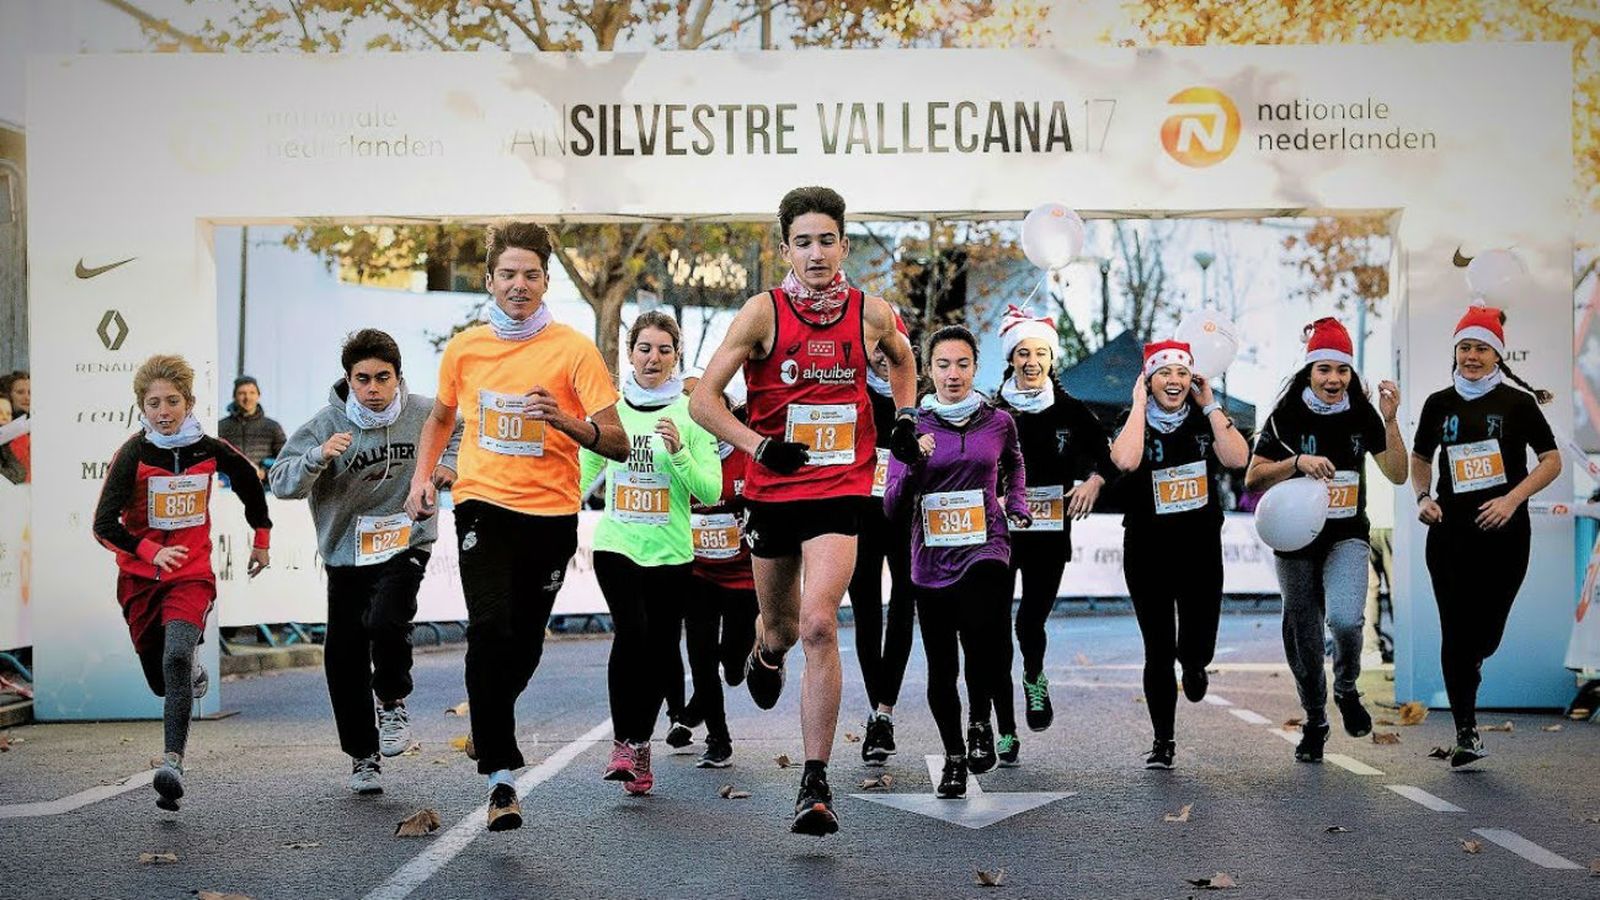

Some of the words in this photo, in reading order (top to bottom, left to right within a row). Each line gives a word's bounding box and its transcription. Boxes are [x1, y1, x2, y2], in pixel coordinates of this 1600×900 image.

[1257, 97, 1390, 121] nationale
[502, 102, 798, 157] ANSILVESTRE
[1257, 127, 1437, 151] nederlanden
[75, 362, 134, 373] RENAU
[802, 362, 857, 383] alquiber
[498, 415, 522, 439] 90
[815, 427, 837, 450] 13
[633, 434, 653, 450] WE
[344, 442, 416, 473] HOLLISTER
[629, 448, 654, 463] RUN
[1464, 457, 1493, 479] 626
[623, 488, 662, 511] 1301
[1169, 480, 1198, 500] 270
[1328, 488, 1349, 507] 27
[165, 493, 196, 517] 856
[938, 510, 973, 533] 394
[372, 530, 400, 552] 622
